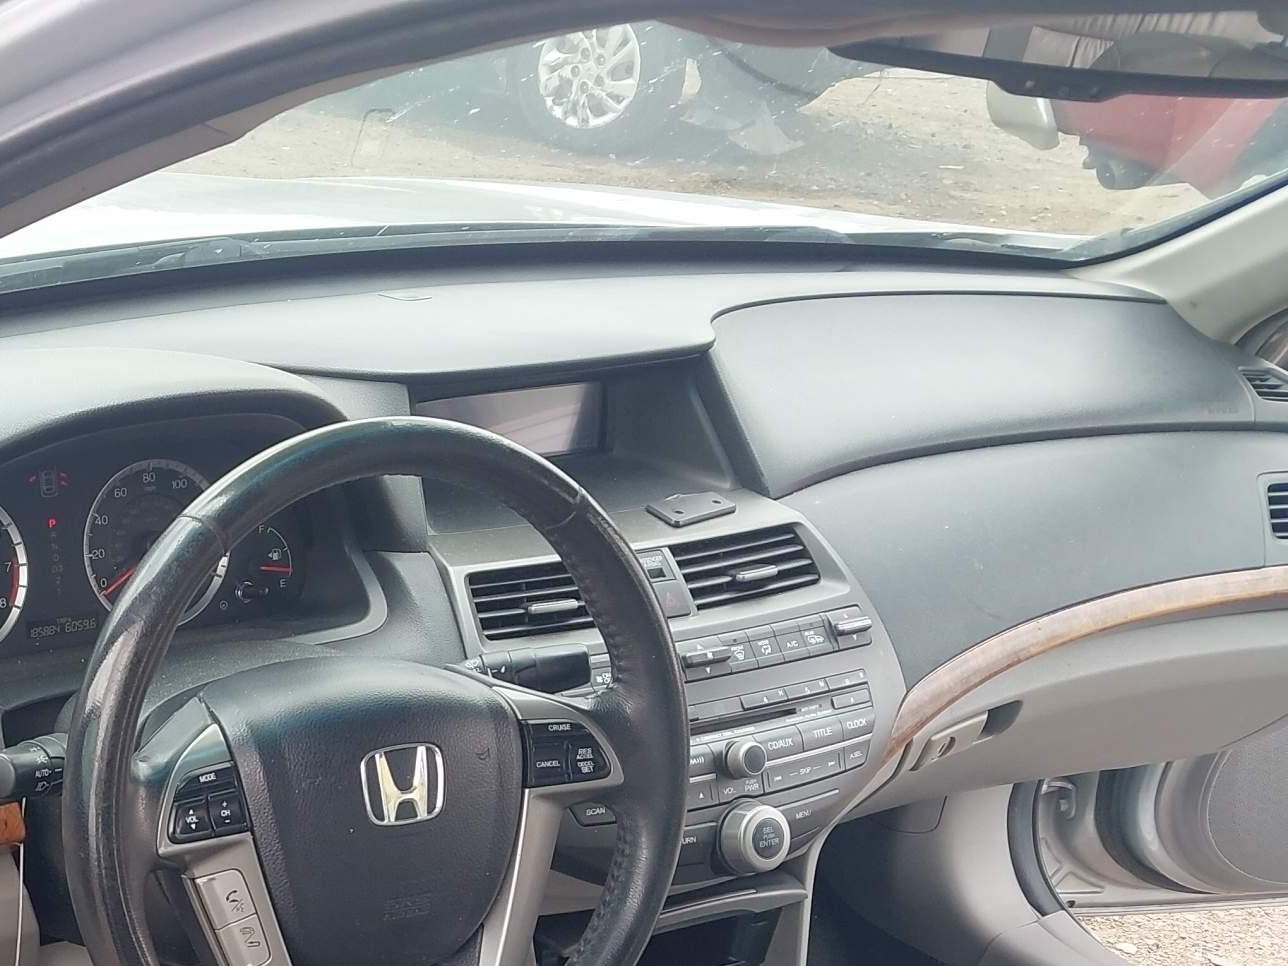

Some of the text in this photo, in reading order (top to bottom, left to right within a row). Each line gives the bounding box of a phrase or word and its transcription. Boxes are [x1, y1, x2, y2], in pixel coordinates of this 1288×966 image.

[142, 472, 156, 484] 80
[171, 478, 188, 489] 100
[114, 487, 127, 498] 60
[48, 518, 57, 529] P
[94, 515, 108, 526] 40
[92, 549, 105, 560] 20
[4, 561, 12, 572] 7
[100, 577, 108, 588] 0
[279, 579, 287, 588] E
[786, 640, 799, 648] A/C
[548, 723, 572, 732] CRUISE
[846, 718, 868, 729] CLOCK
[813, 728, 833, 738] TITLE
[767, 737, 794, 751] CD/AUX
[535, 759, 561, 768] CANCEL
[35, 769, 49, 778] AUTO
[199, 772, 217, 783] MODE
[723, 787, 737, 795] VOL
[744, 783, 760, 793] PWR
[220, 809, 231, 818] CH
[586, 807, 607, 816] SCAN
[185, 815, 199, 824] VOL
